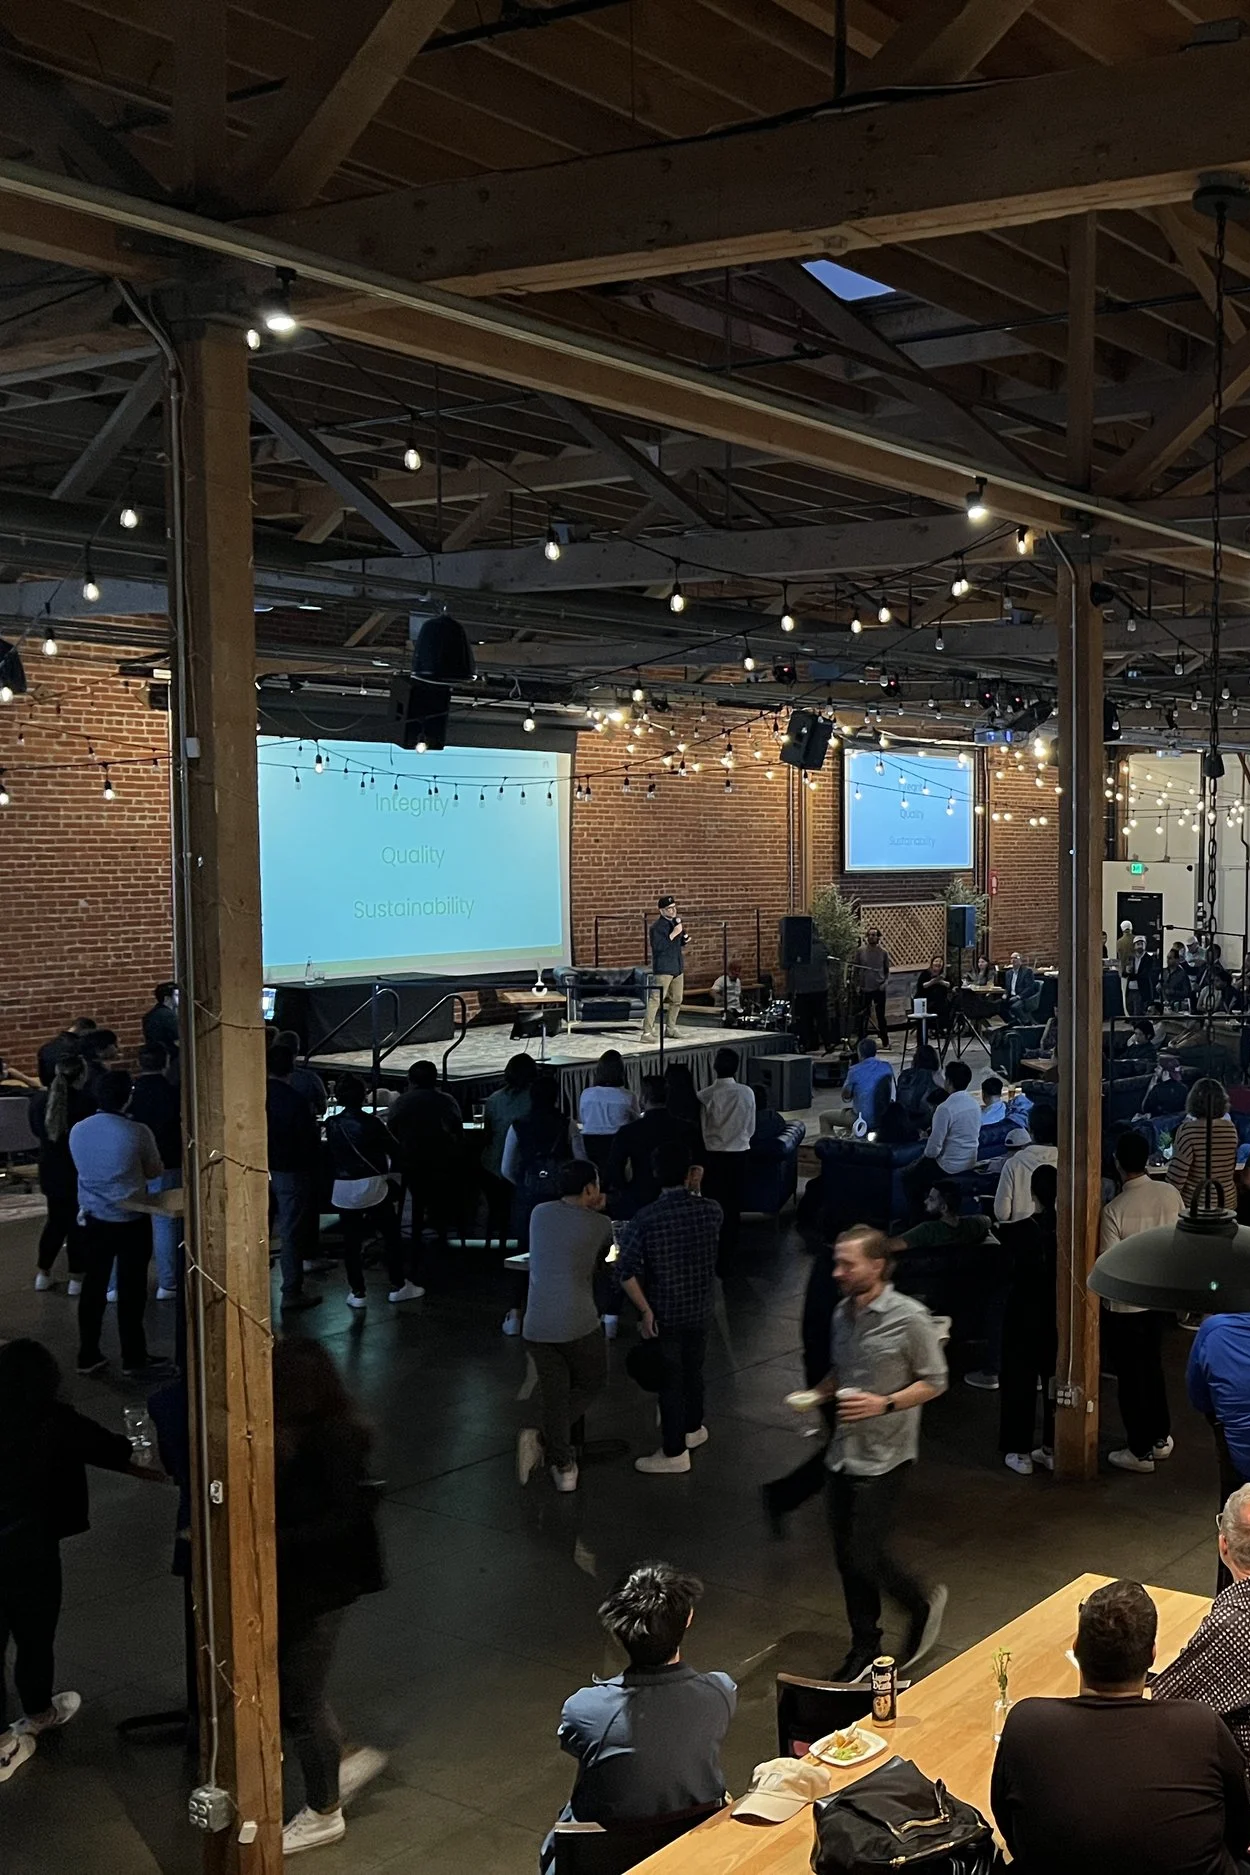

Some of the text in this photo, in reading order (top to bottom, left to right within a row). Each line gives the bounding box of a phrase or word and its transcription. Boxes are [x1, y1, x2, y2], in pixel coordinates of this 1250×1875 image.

[375, 793, 449, 817] Integrity
[381, 845, 445, 868] Quality
[354, 896, 475, 919] Sustainability
